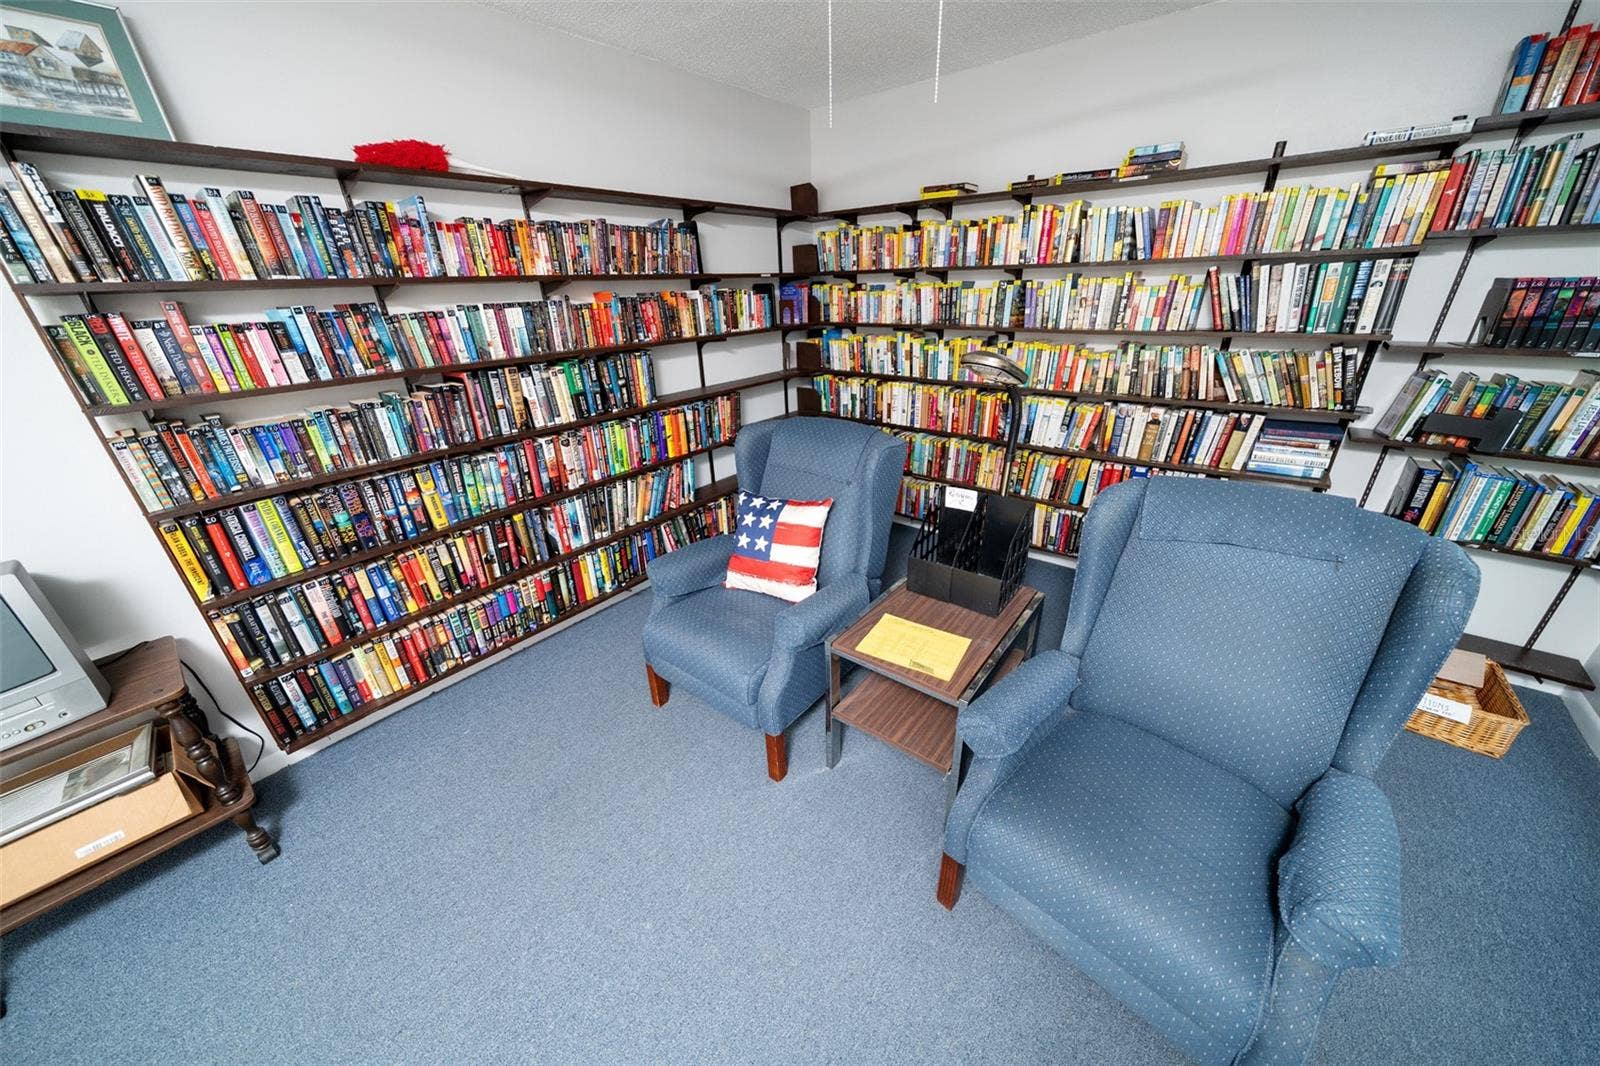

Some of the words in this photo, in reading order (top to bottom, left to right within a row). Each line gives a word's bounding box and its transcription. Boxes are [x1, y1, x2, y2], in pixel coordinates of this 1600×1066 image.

[112, 196, 130, 206] BA
[149, 187, 169, 205] AVID
[95, 209, 124, 246] BALDACCI
[328, 220, 345, 245] BELL
[337, 225, 351, 242] TED
[67, 321, 93, 346] BLACK
[87, 319, 108, 334] RED
[108, 350, 122, 364] TED
[109, 317, 132, 342] WHITE
[129, 352, 142, 365] TED
[1333, 365, 1343, 389] TEBOW
[213, 426, 230, 445] JAMES
[222, 444, 244, 474] PATTERSON
[234, 532, 256, 559] CORNWELL
